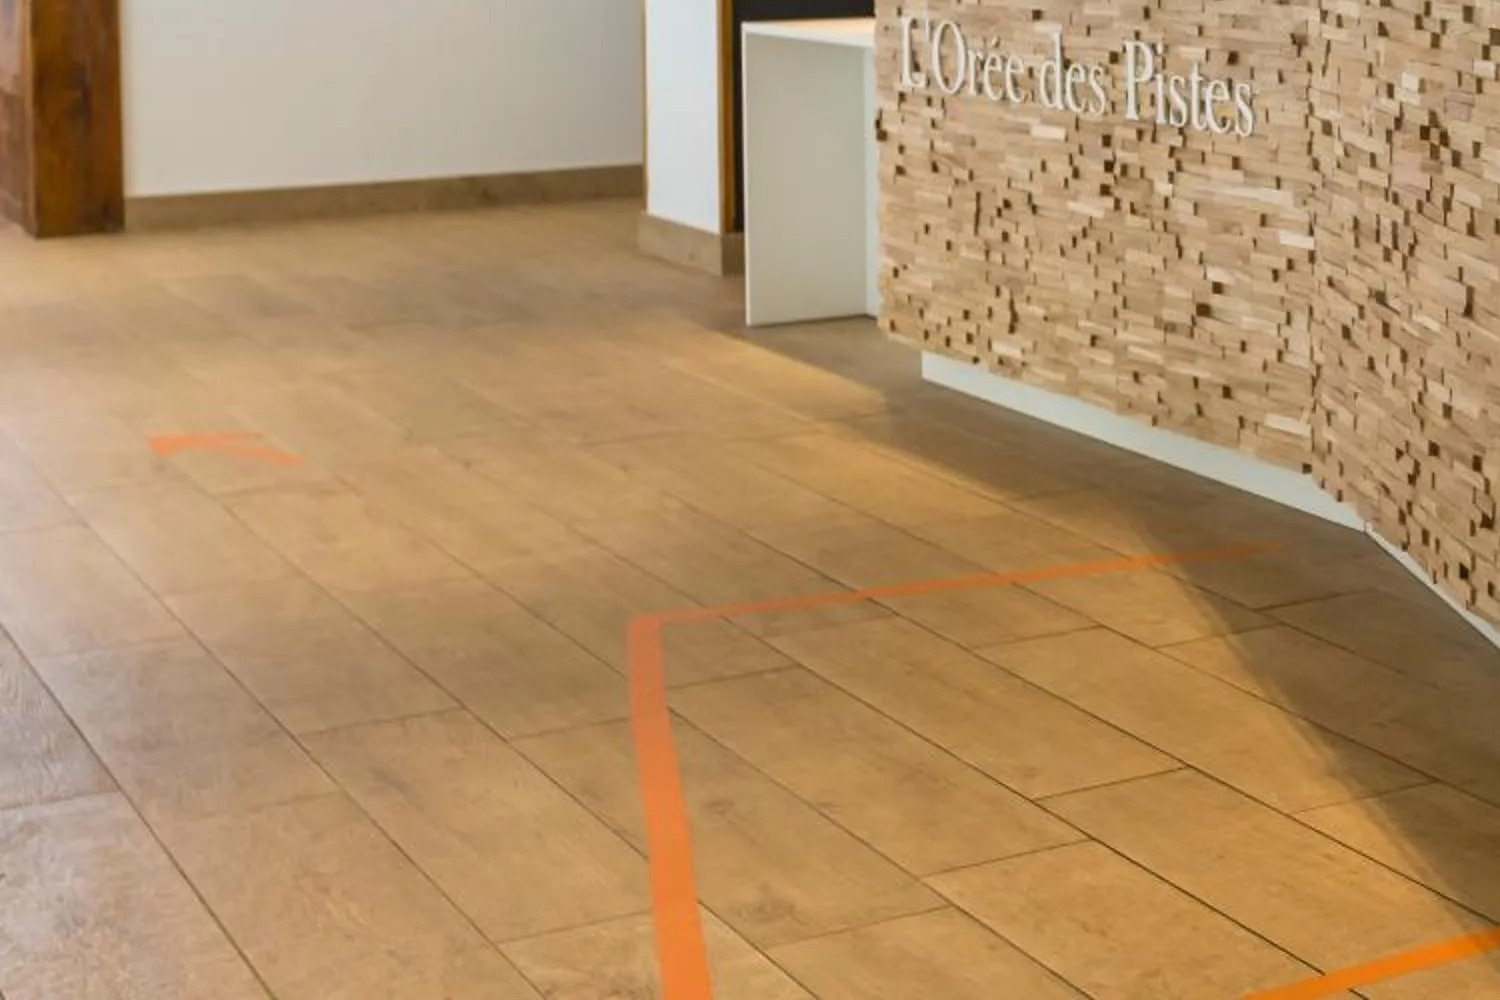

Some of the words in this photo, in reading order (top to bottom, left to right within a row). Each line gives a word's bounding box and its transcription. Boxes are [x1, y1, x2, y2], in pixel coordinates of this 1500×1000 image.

[899, 14, 1025, 103] L'Orée
[1039, 24, 1106, 116] des
[1122, 39, 1255, 137] Pistes
